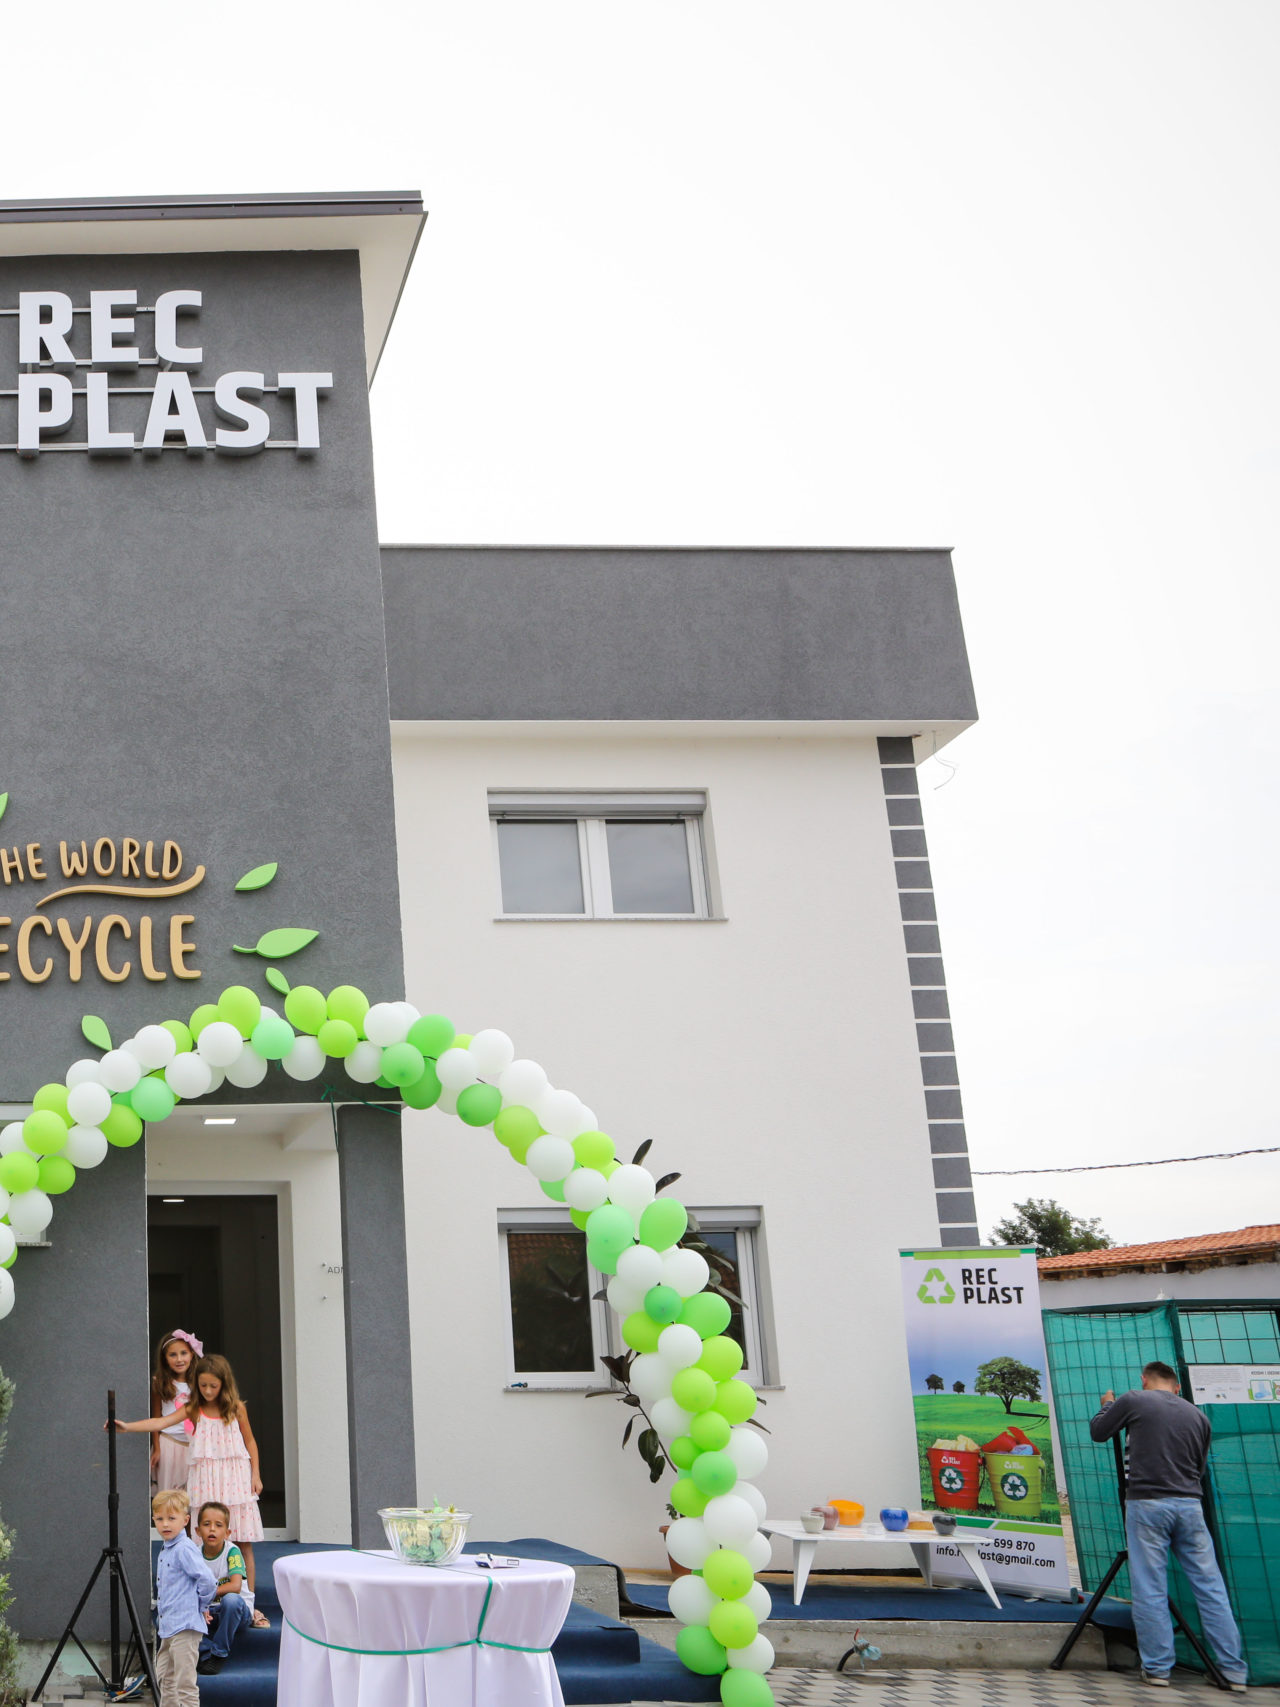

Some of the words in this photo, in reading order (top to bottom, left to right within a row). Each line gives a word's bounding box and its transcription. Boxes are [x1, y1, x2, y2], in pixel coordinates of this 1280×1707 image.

[19, 290, 203, 368] REC
[18, 372, 333, 456] PLAST
[59, 837, 184, 881] WORLD
[961, 1267, 998, 1286] REC
[963, 1286, 1024, 1305] PLAST
[994, 1538, 1013, 1549] 699
[1016, 1540, 1035, 1552] 870
